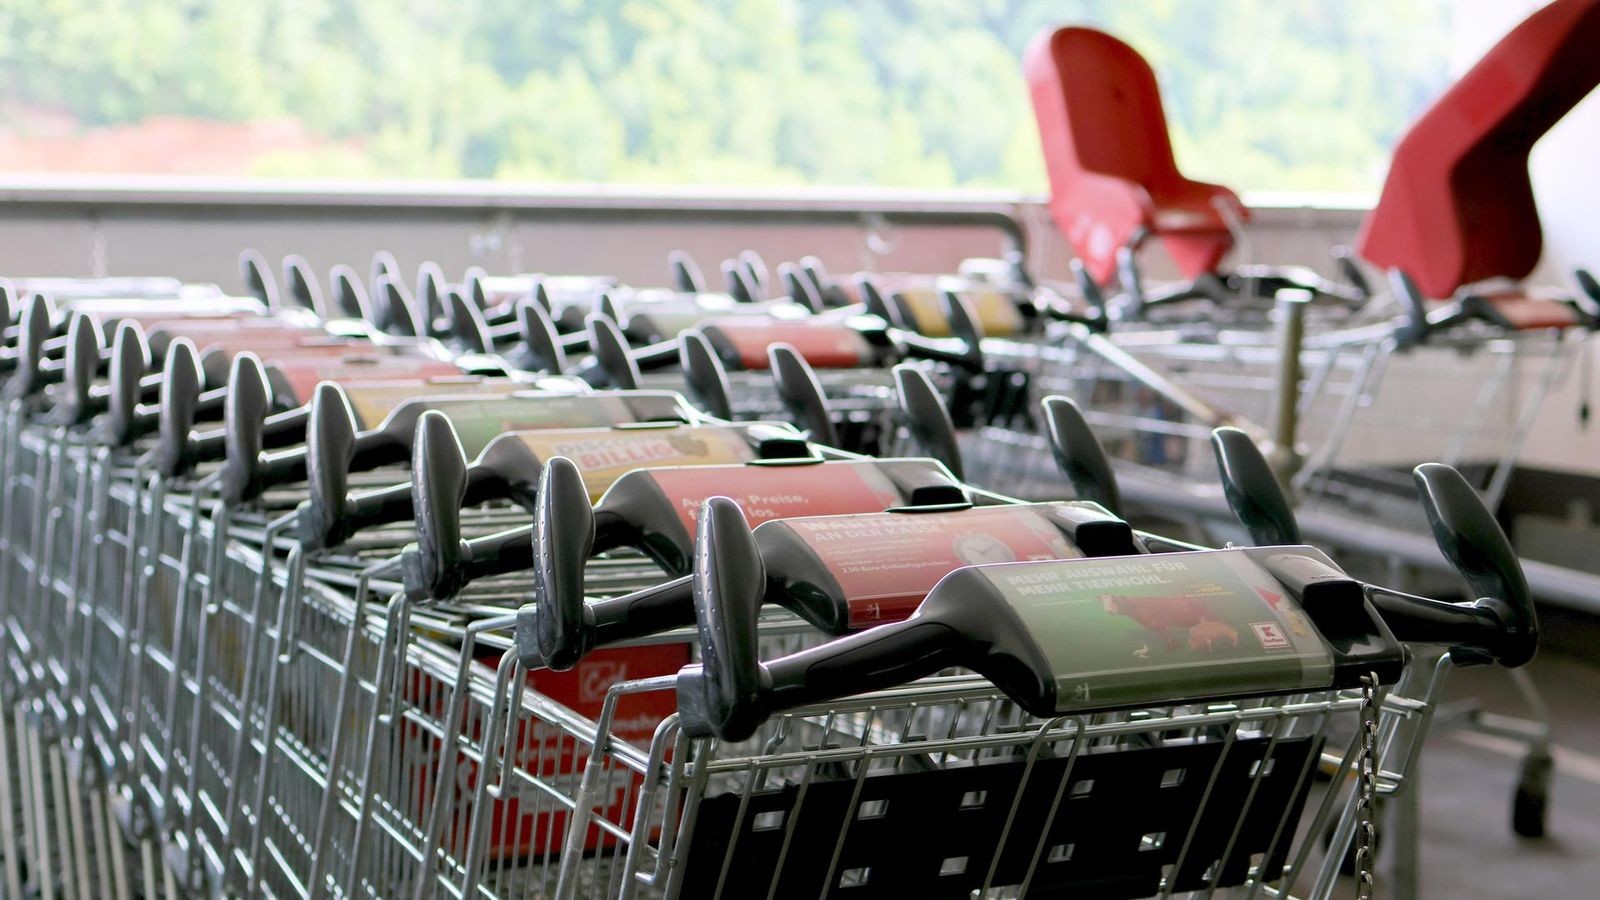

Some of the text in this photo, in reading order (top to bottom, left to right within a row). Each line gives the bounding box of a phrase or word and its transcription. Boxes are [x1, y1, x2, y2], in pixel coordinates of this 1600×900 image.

[580, 443, 674, 468] BILLIG
[748, 493, 809, 505] Preise,
[747, 507, 780, 518] los.
[815, 524, 944, 542] AN DER KASSE
[1007, 560, 1188, 585] MEHR AUSWAHL FÜR
[1015, 575, 1174, 596] MEHR TIERWOHL.
